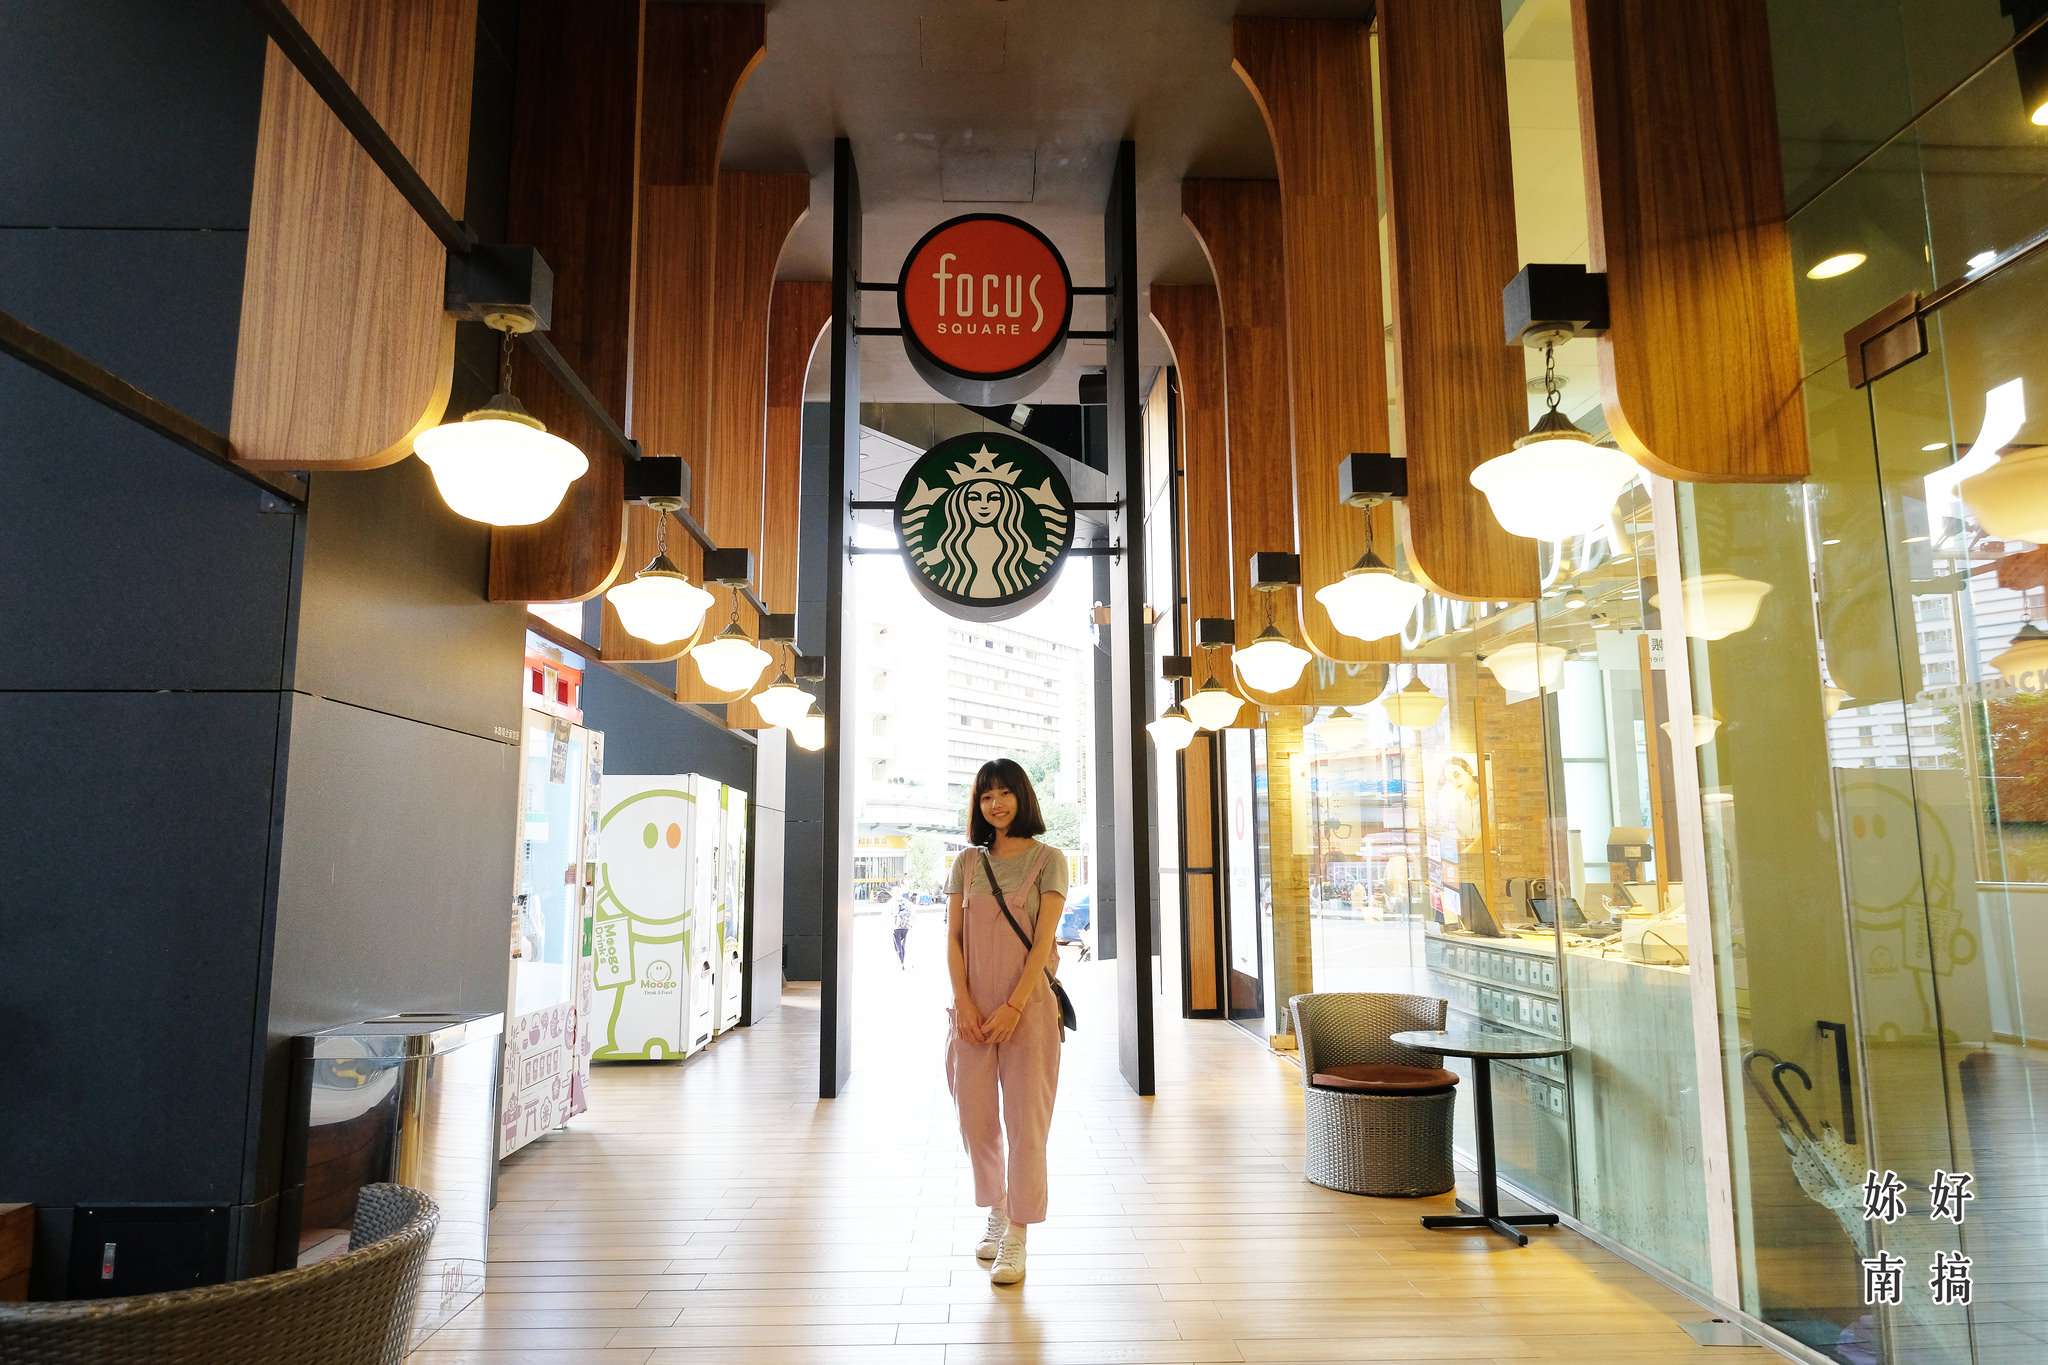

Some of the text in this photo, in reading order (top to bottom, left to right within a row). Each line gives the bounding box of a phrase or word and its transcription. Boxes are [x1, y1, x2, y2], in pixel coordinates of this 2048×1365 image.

[937, 323, 1021, 335] SQUARE
[605, 923, 620, 975] Moogo
[640, 979, 677, 990] Moogo
